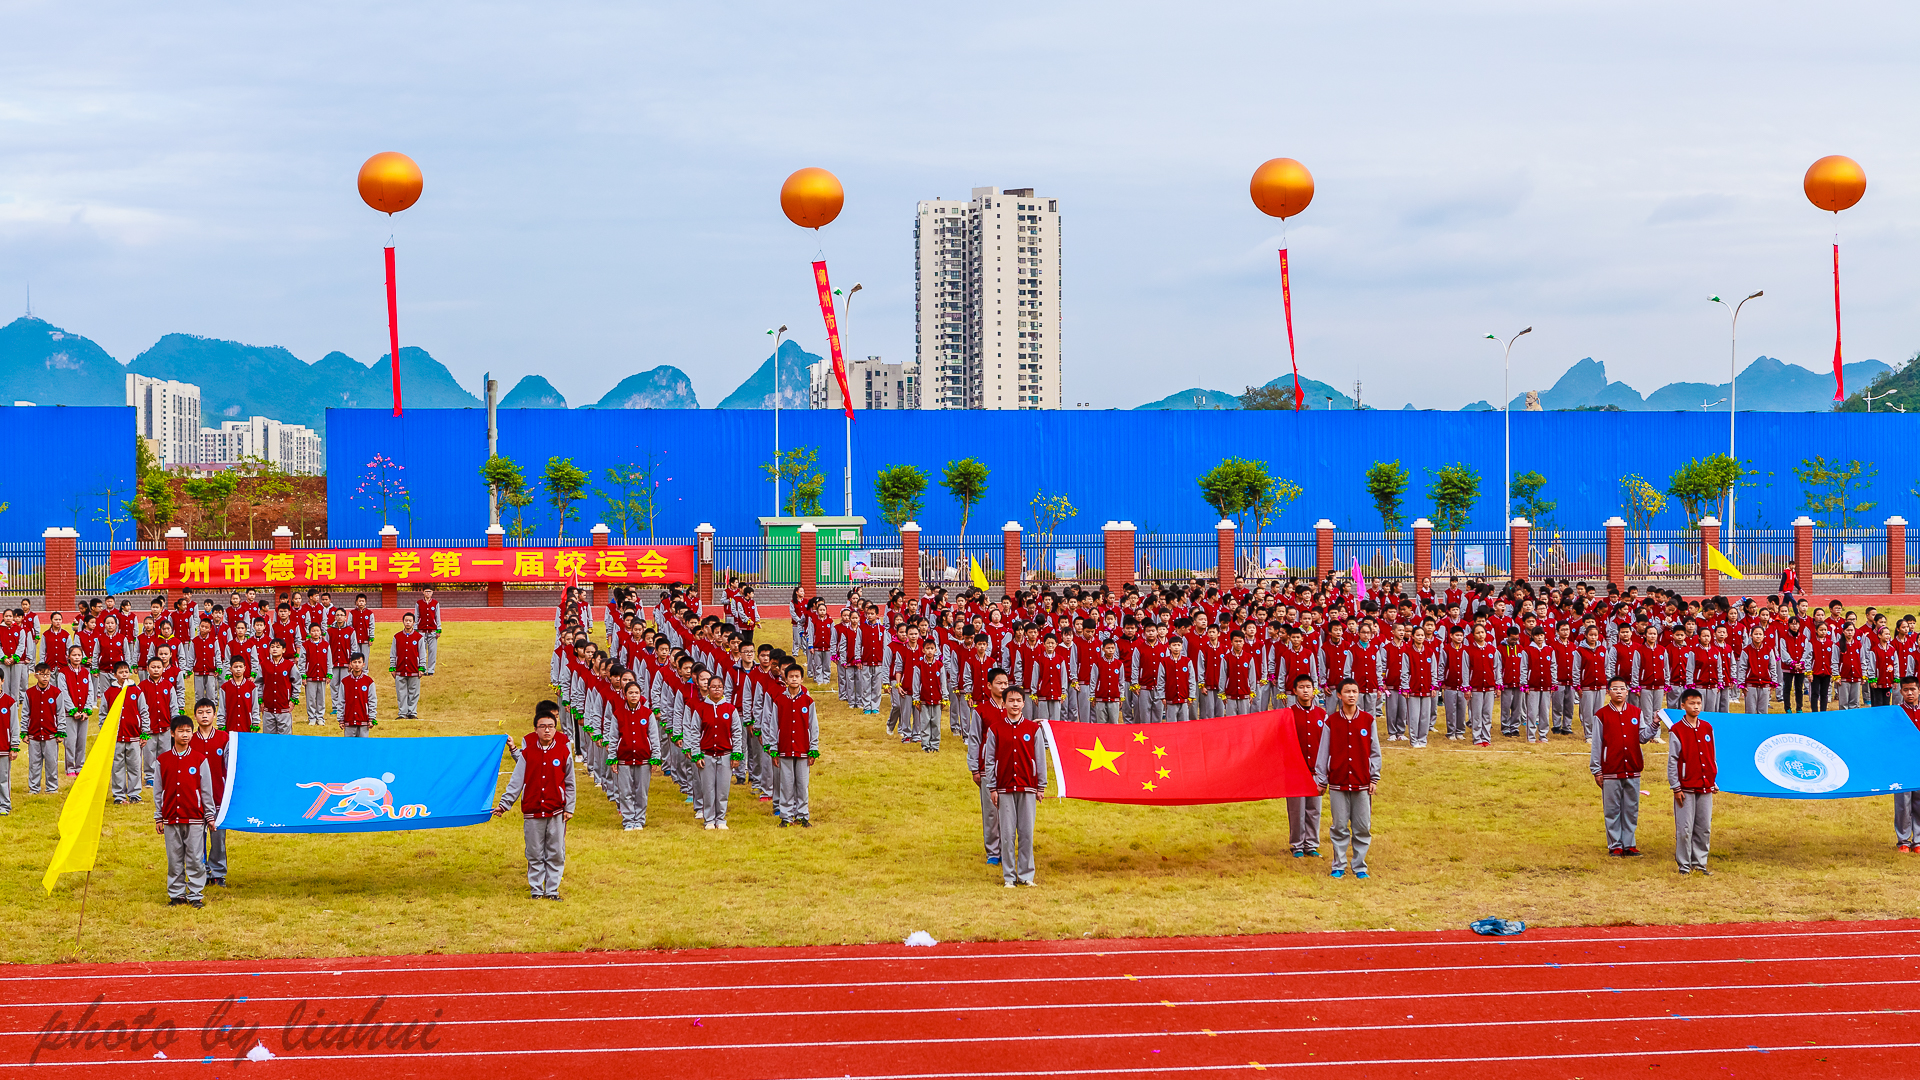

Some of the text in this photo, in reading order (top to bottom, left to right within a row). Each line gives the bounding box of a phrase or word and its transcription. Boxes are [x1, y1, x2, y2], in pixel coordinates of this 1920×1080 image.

[138, 549, 671, 586] 柳州市德润中学第一届校运会
[1757, 735, 1837, 764] DERUN MIDDLE SCHOOL
